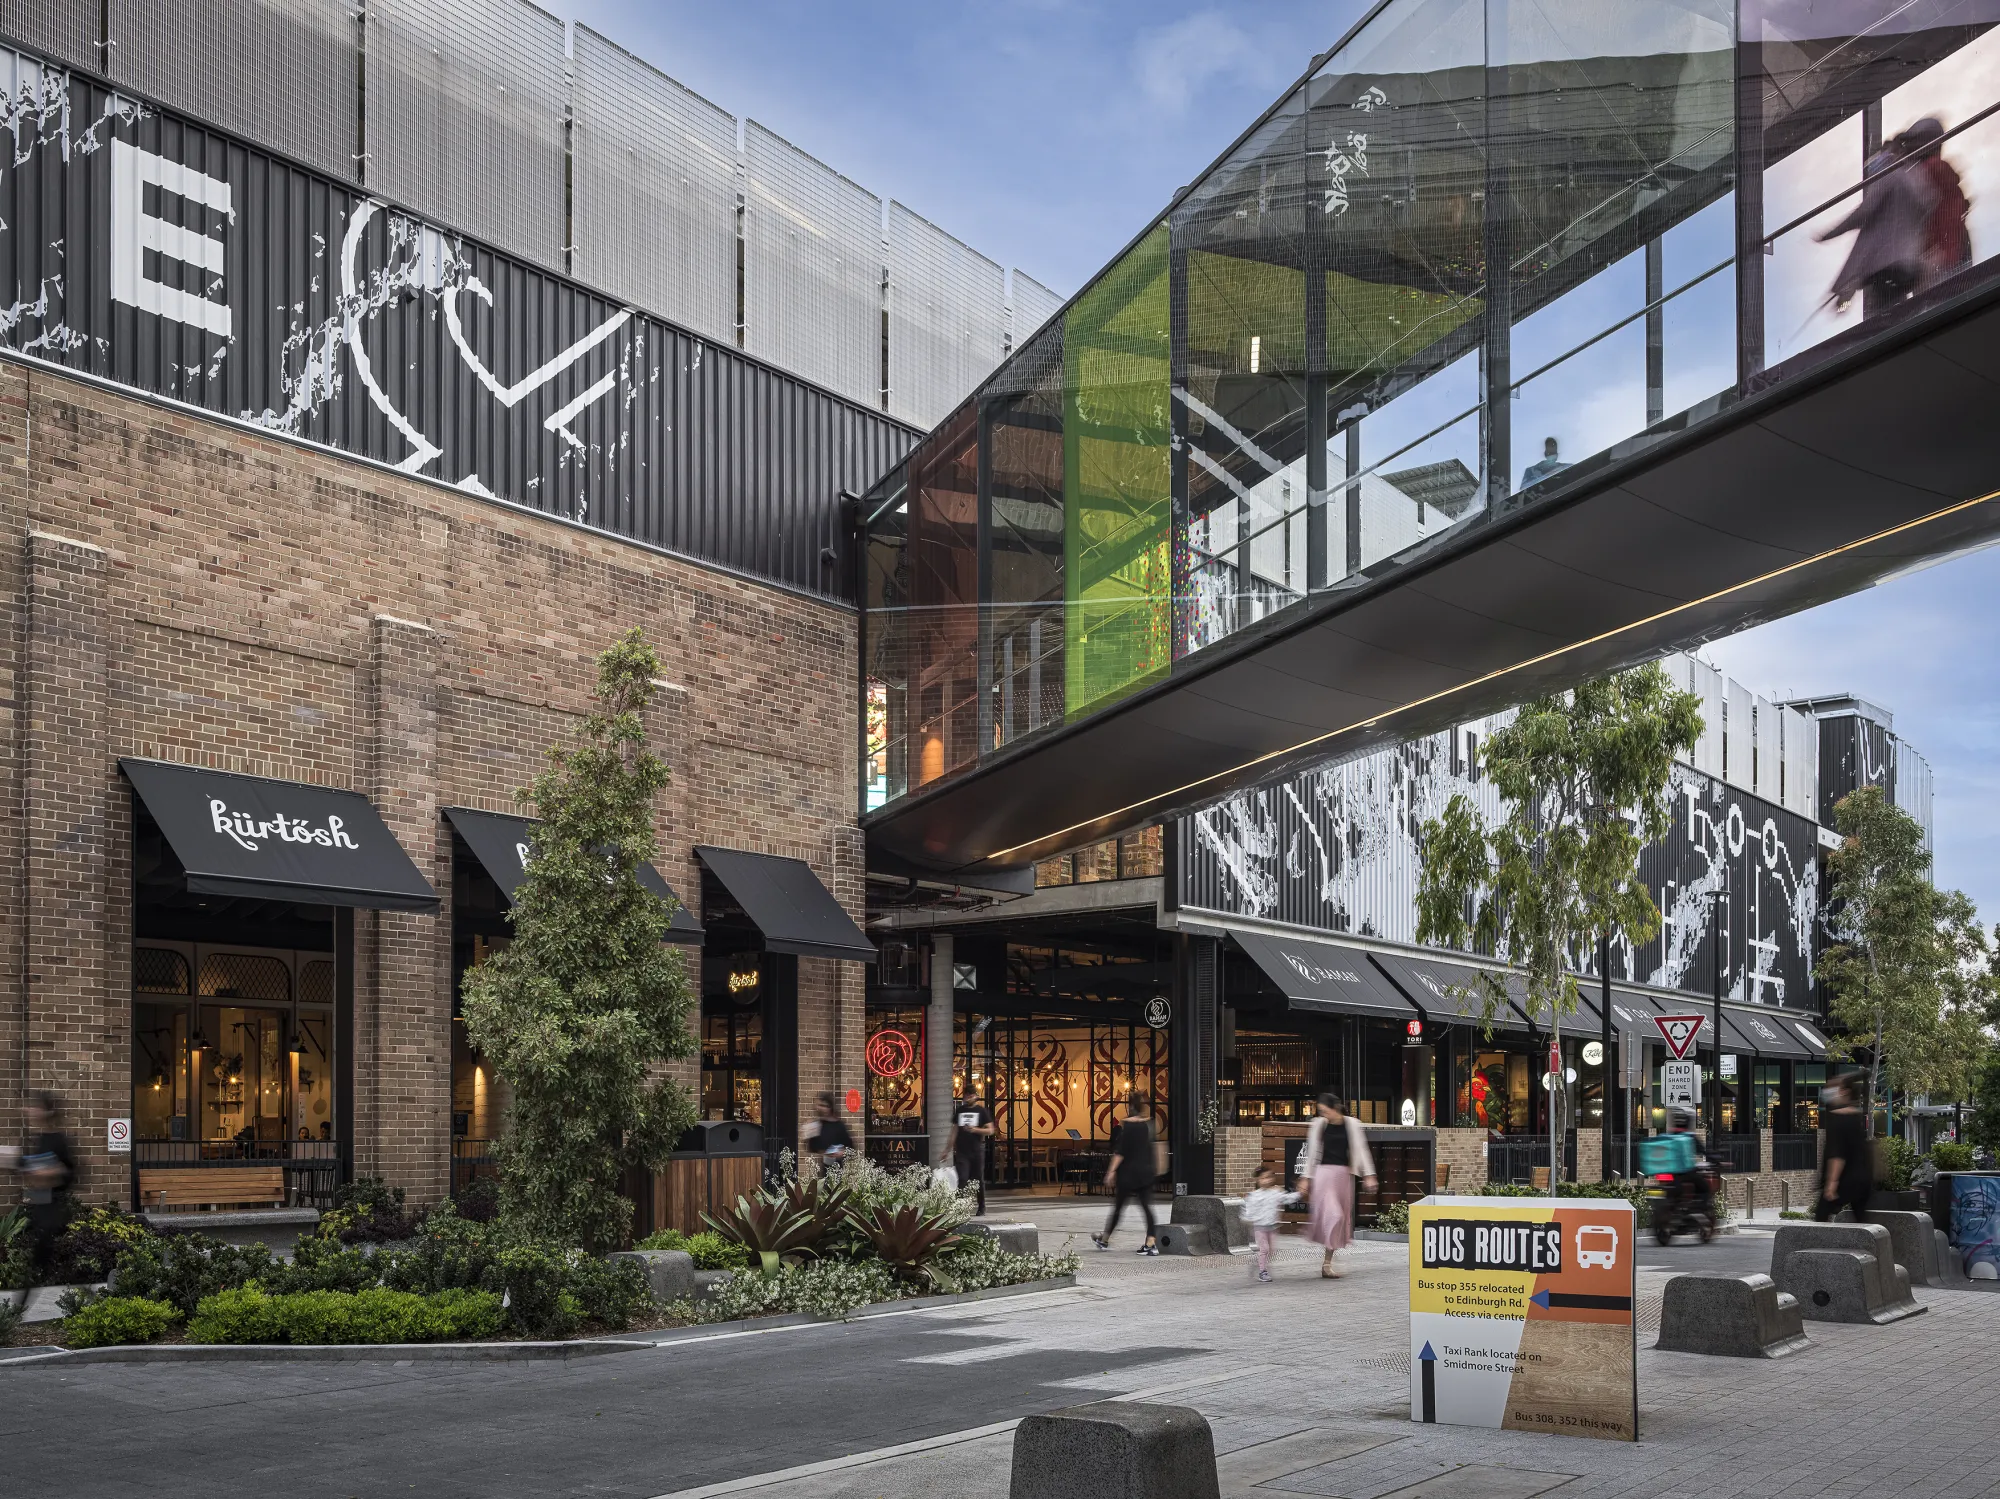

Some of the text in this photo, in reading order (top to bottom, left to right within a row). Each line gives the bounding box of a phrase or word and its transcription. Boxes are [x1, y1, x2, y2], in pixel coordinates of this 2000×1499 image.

[1668, 1065, 1691, 1075] END
[865, 1140, 917, 1152] AMAN
[1424, 1226, 1560, 1268] BUS ROUTES
[1418, 1280, 1525, 1294] Bus stop 355 relocated
[1444, 1295, 1525, 1309] to Edinburgh Rd.
[1444, 1309, 1525, 1321] Access via centre
[1443, 1346, 1541, 1361] Taxi Rank located on
[1444, 1360, 1524, 1374] Smidmore Street
[1515, 1412, 1622, 1432] Bus 308, 352 this way
